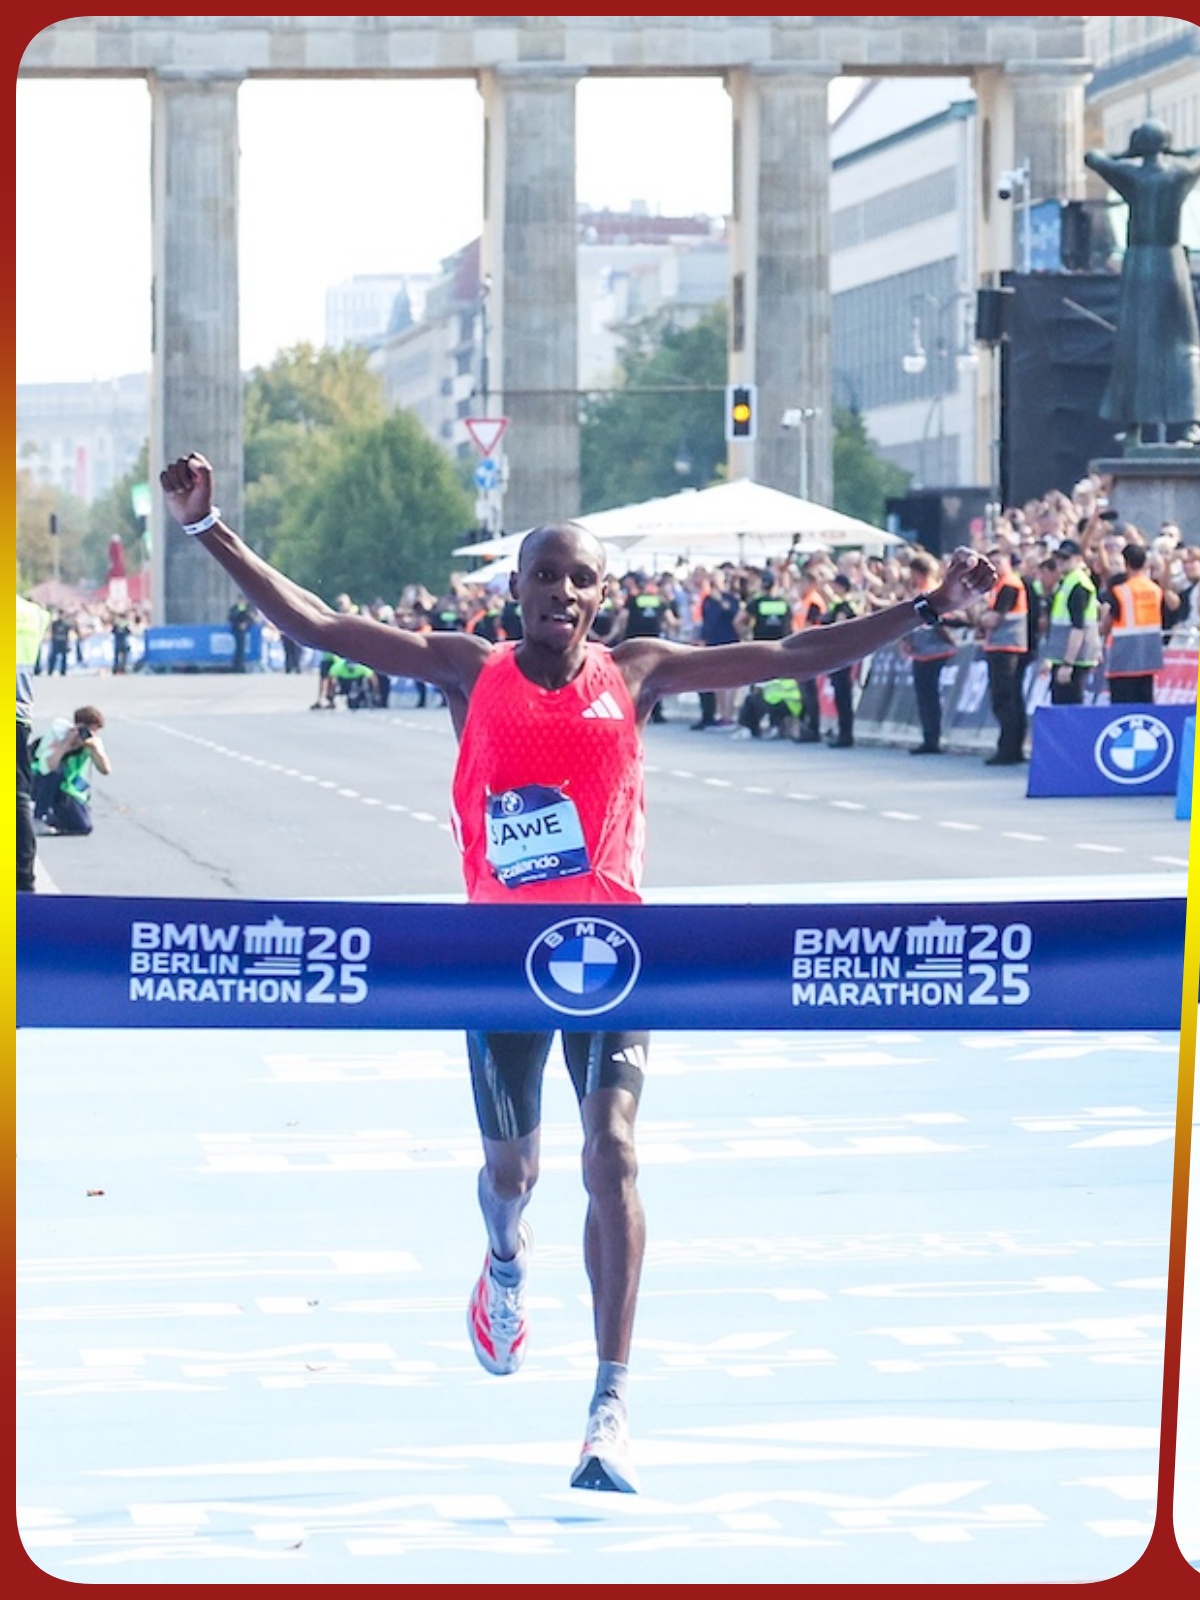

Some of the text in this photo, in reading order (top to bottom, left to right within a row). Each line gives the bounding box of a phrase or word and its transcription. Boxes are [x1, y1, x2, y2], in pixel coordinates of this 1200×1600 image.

[131, 922, 240, 952] BMW
[307, 926, 371, 962] 20
[543, 922, 627, 949] BMW
[794, 926, 902, 956] BMW
[968, 923, 1033, 961] 20
[130, 952, 239, 975] BERLIN
[792, 956, 900, 979] BERLIN
[129, 977, 301, 1003] MARATHON
[305, 962, 369, 1004] 25
[792, 982, 964, 1006] MARATHON
[968, 963, 1031, 1006] 25
